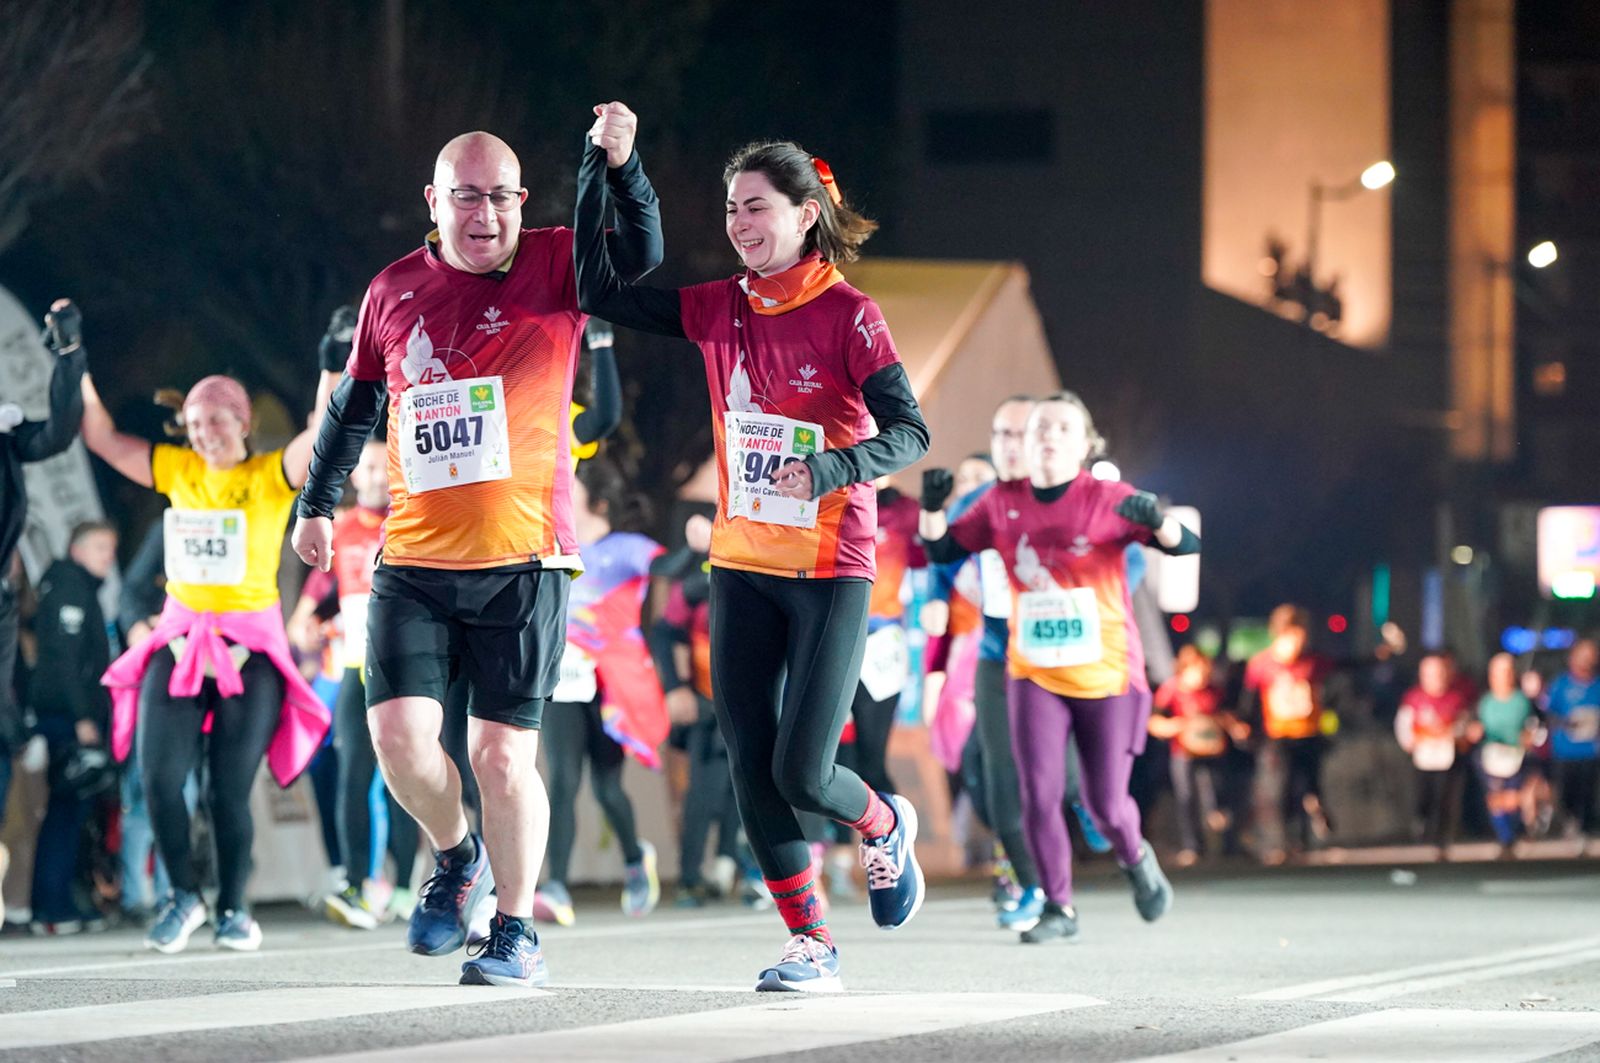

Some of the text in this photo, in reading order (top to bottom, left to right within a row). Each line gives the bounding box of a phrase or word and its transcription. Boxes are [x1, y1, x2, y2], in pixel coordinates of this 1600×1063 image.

[413, 395, 444, 408] NOCHE
[447, 393, 460, 403] DE
[424, 404, 461, 421] ANTÓN
[415, 415, 483, 455] 5047
[740, 424, 768, 437] NOCHE
[770, 427, 784, 439] DE
[745, 437, 783, 452] ANTÓN
[450, 449, 475, 459] Manuel
[750, 486, 761, 494] del
[184, 538, 227, 557] 1543
[1032, 619, 1083, 639] 4599
